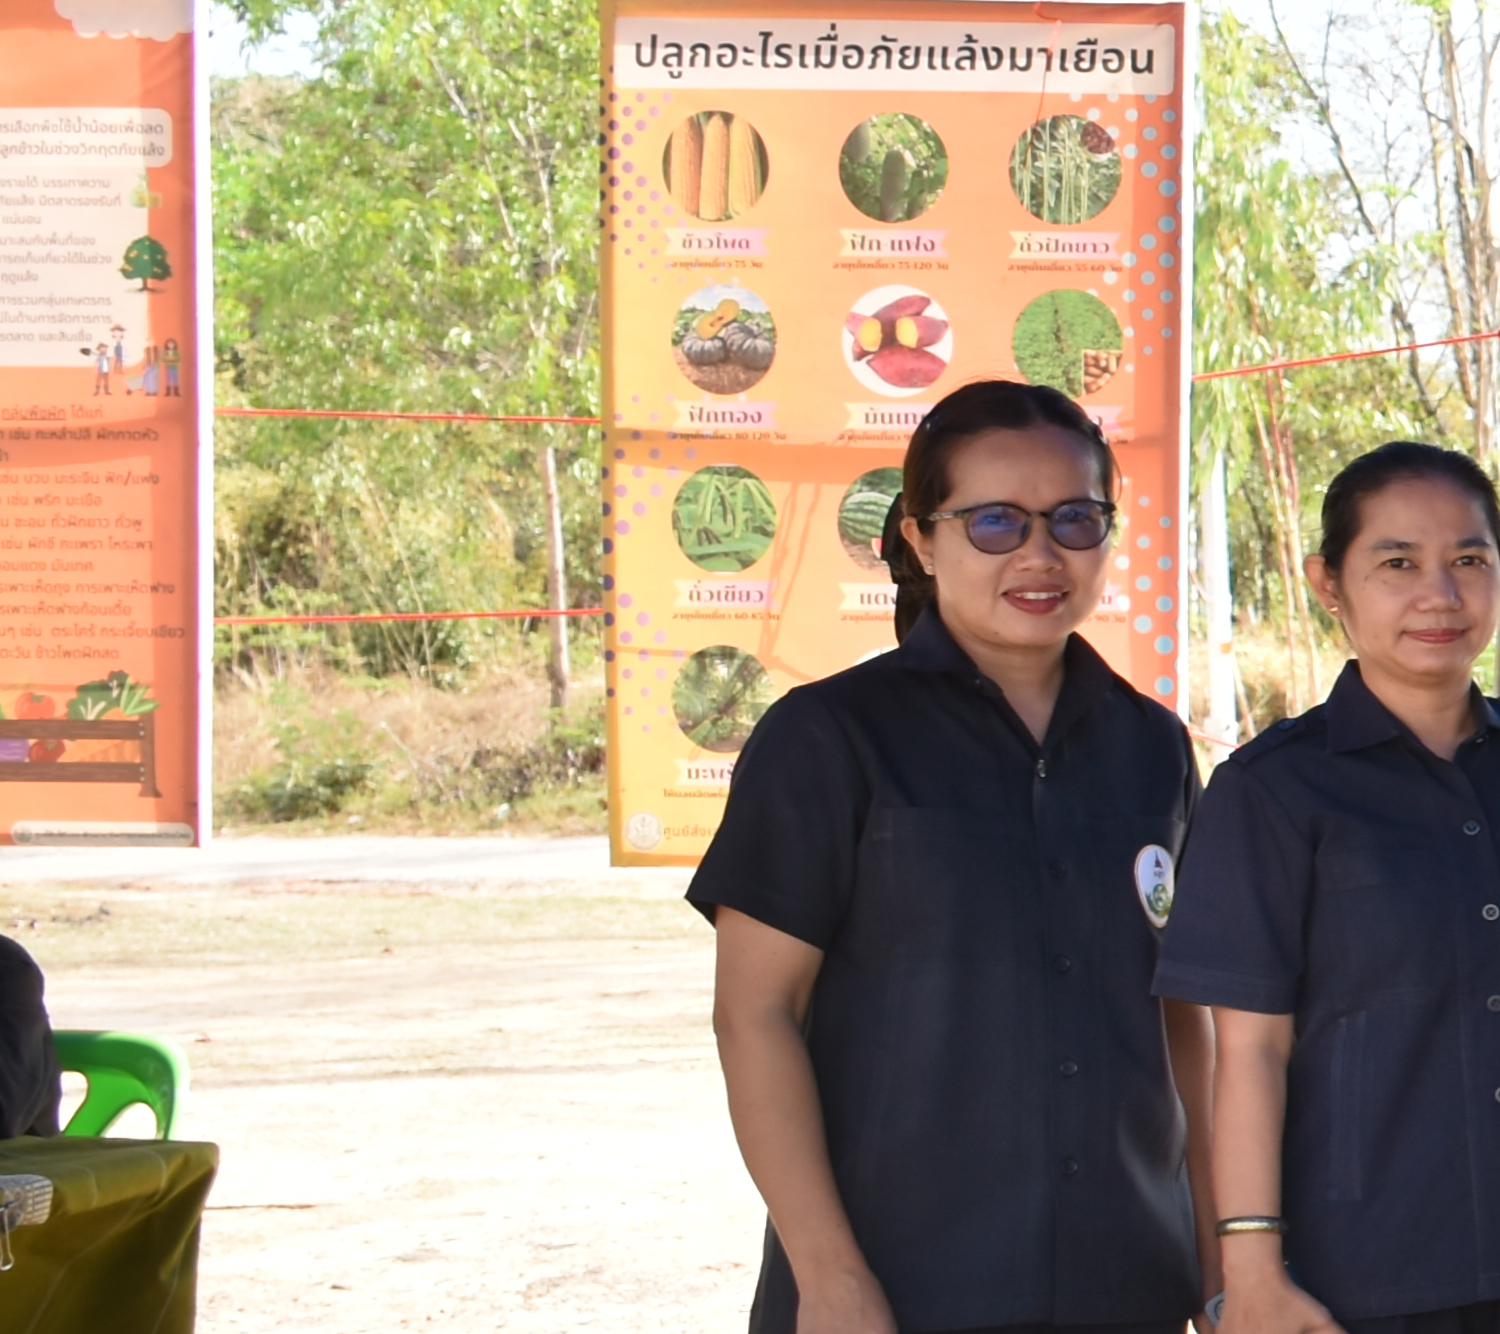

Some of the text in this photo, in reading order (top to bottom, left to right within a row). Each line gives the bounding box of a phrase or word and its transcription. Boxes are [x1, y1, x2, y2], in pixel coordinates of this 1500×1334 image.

[634, 23, 1154, 80] ปลูกอะไรเมื่อภัยแล้งมาเยือน
[863, 405, 930, 426] มันเท
